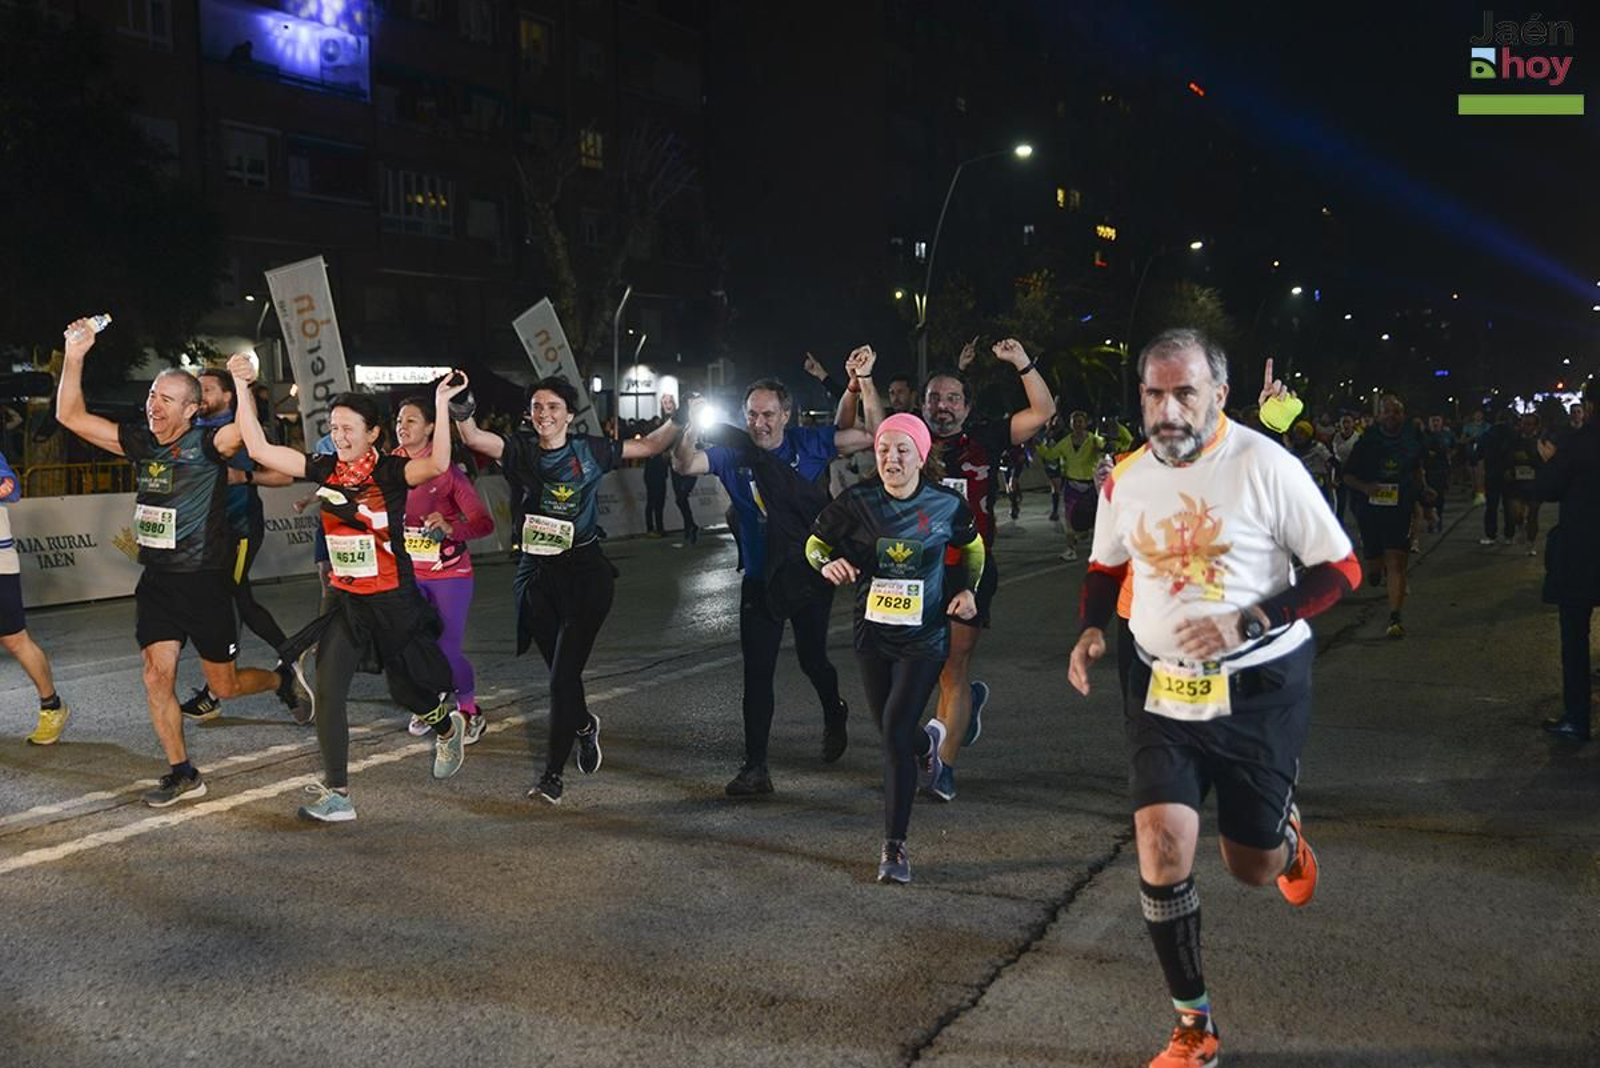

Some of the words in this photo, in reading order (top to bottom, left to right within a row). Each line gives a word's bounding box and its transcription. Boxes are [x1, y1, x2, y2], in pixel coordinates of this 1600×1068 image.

[293, 515, 321, 530] RURA
[12, 536, 45, 554] AJA
[45, 533, 97, 551] RURAL
[875, 594, 912, 610] 7628
[1164, 676, 1213, 698] 1253
